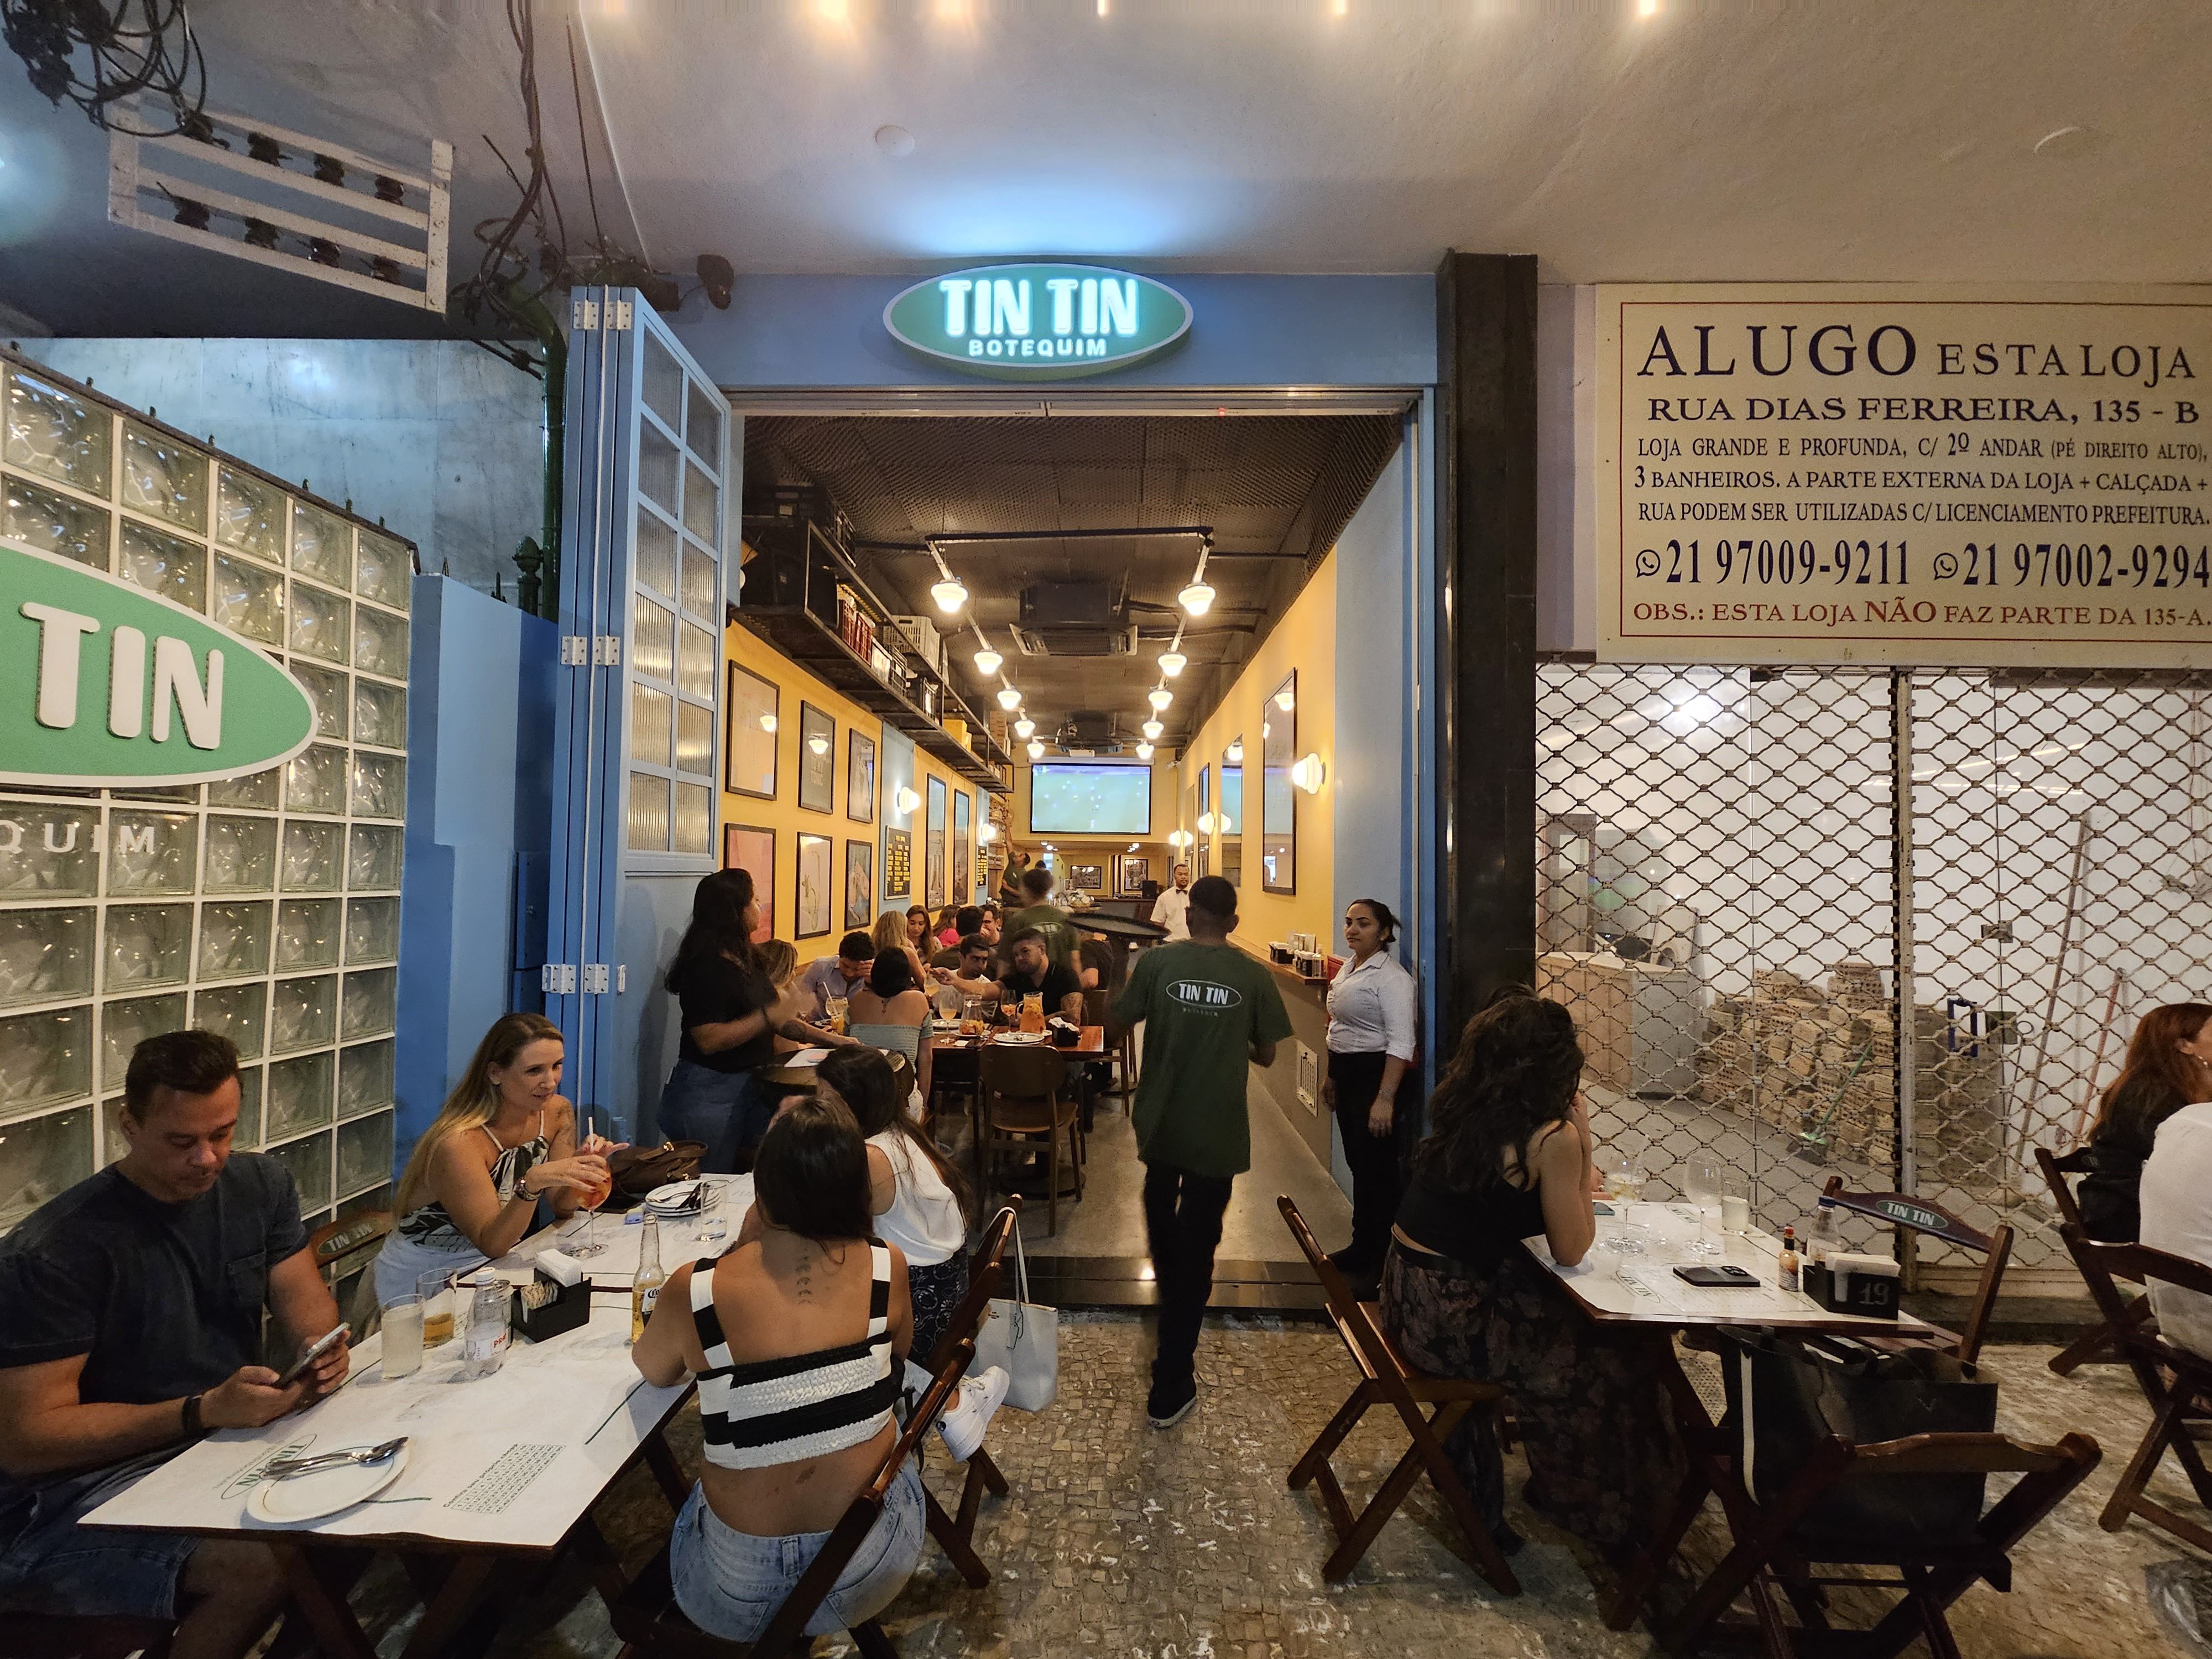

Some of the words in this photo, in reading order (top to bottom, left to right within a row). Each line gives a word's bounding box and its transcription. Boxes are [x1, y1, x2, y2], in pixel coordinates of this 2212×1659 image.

[939, 279, 1031, 336] TIN
[1047, 278, 1138, 336] TIN
[968, 338, 1107, 357] BOTEQUIM
[1637, 325, 1916, 375] ALUGO
[1937, 343, 2069, 375] ESTA
[2080, 345, 2195, 388] LOJA
[1648, 399, 1735, 421] RUA
[1746, 398, 1845, 420] DIAS
[1858, 398, 2078, 425] FERREIRA,
[2094, 400, 2140, 422] 135
[2176, 401, 2199, 423] B
[1639, 439, 1681, 461] LOJA
[1693, 439, 1767, 456] GRANDE
[1779, 439, 1790, 456] E
[1801, 438, 1906, 457] PROFUNDA,
[1918, 437, 1938, 457] C/
[1980, 439, 2043, 457] ANDAR
[2052, 438, 2075, 459] (PÉ
[2085, 442, 2148, 458] DIREITO
[2158, 444, 2207, 462] ALTO),
[1635, 466, 1645, 487] 3
[1652, 471, 1780, 488] BANHEIROS.
[1787, 472, 1801, 487] A
[1807, 472, 1876, 488] PARTE
[1882, 472, 1985, 489] EXTERNA
[1991, 472, 2020, 488] DA
[2025, 473, 2074, 494] LOJA
[2080, 477, 2090, 488] +
[2096, 473, 2192, 494] CALÇADA
[2198, 479, 2208, 490] +
[1639, 503, 1676, 521] RUA
[1681, 503, 1746, 520] PODEM
[1752, 503, 1788, 521] SER
[1796, 503, 1907, 521] UTILIZADAS
[1913, 503, 1932, 523] C/
[1936, 504, 2088, 523] LICENCIAMENTO
[2093, 505, 2210, 525] PREFEITURA.
[1667, 540, 1700, 583] 21
[1717, 540, 1908, 585] 97009-9211
[1964, 543, 1998, 585] 21
[2015, 544, 2209, 588] 97002-9294
[1634, 603, 1703, 620] OBS.:
[1713, 604, 1785, 621] ESTA
[1792, 604, 1857, 627] LOJA
[1864, 597, 1936, 623] NÃO
[1944, 606, 1993, 623] FAZ
[2001, 607, 2090, 624] PARTE
[2099, 608, 2136, 624] DA
[2146, 608, 2211, 625] 135-A.
[19, 601, 225, 750] TIN
[1178, 983, 1201, 1001] TIN
[1206, 987, 1229, 1005] TIN
[1887, 1202, 1908, 1218] TIN
[1912, 1209, 1935, 1225] TIN
[327, 1233, 350, 1251] TIN
[1859, 1282, 1890, 1306] 19
